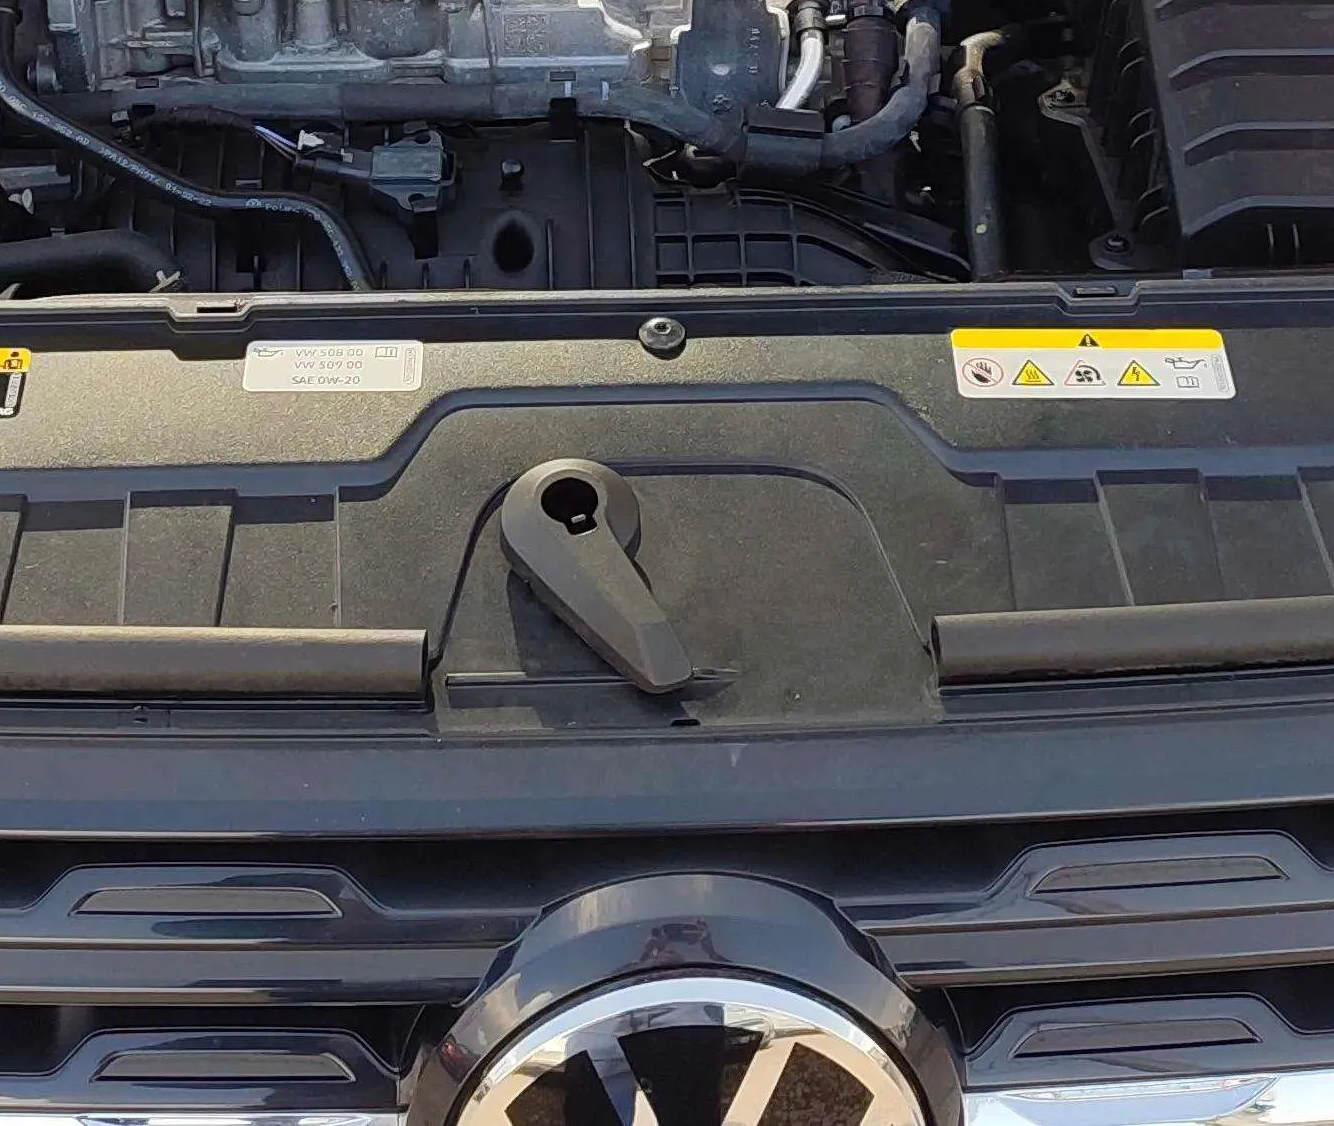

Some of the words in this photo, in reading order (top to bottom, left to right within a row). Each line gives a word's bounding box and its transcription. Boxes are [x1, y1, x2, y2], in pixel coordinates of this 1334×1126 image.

[295, 348, 316, 357] VW
[319, 348, 343, 357] 508
[346, 348, 364, 357] 00
[294, 361, 315, 370] VW
[318, 361, 342, 370] 509
[345, 360, 364, 370] 00
[291, 376, 314, 385] SAE
[317, 376, 362, 385] 0W-20
